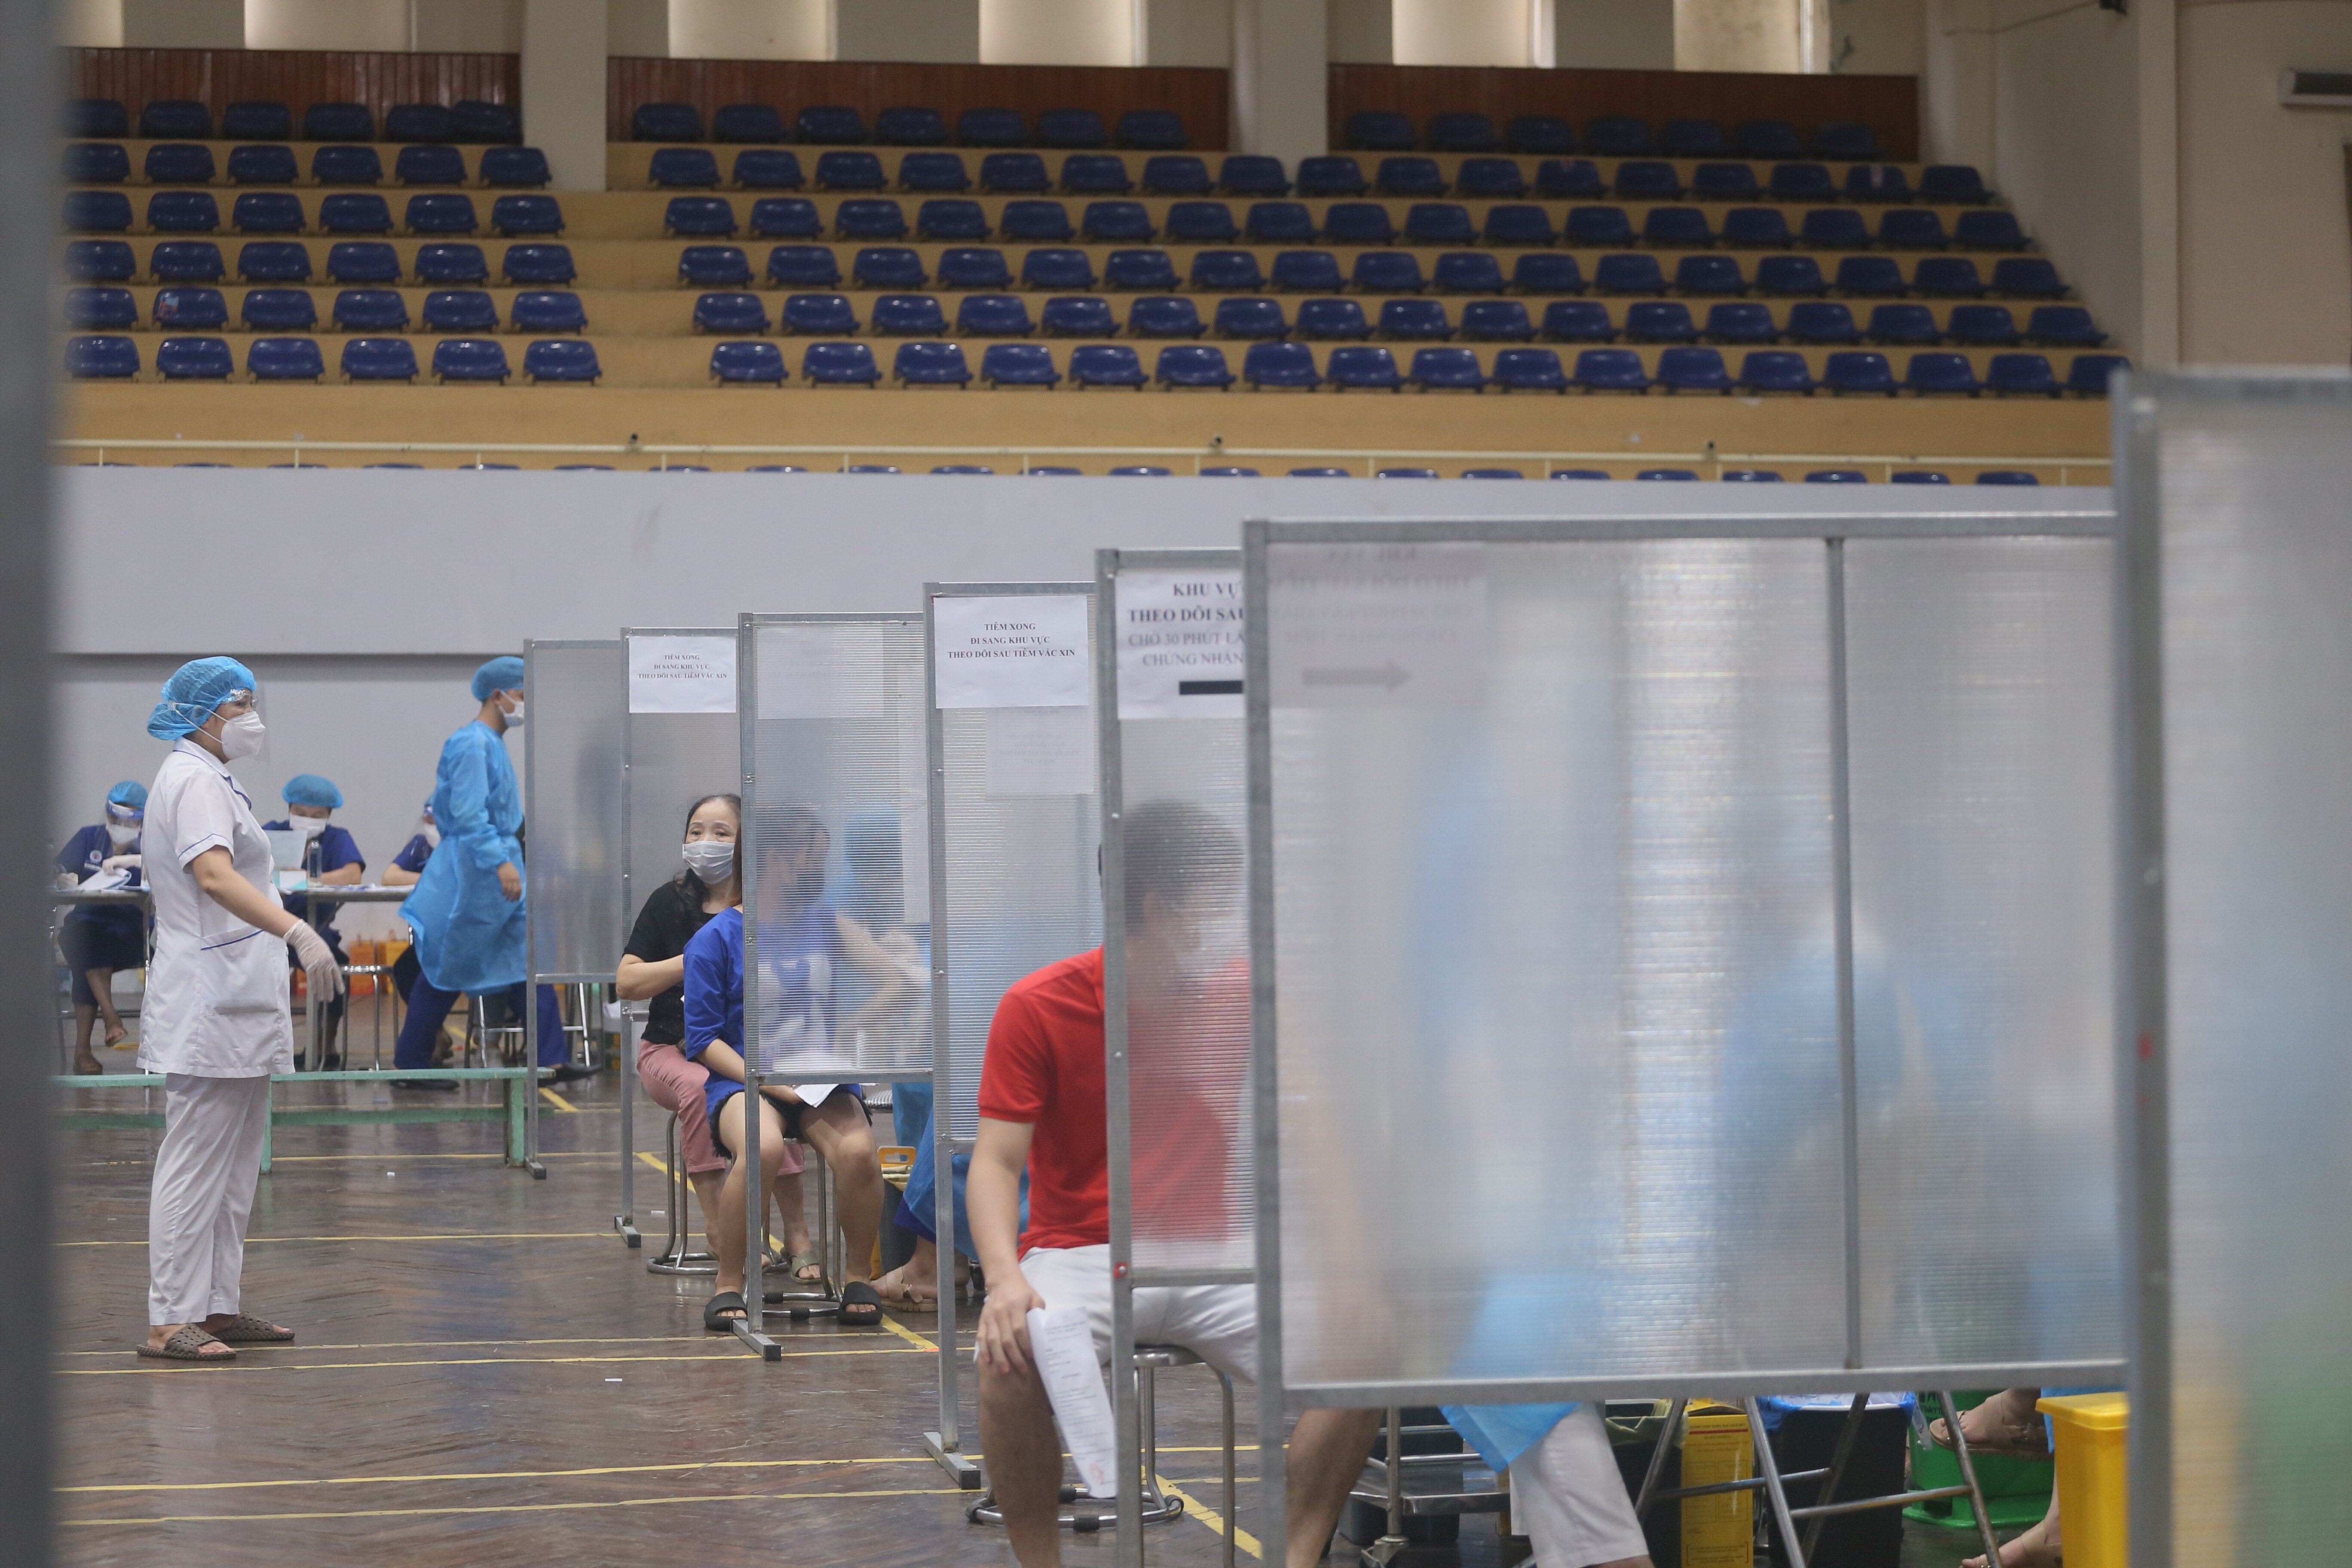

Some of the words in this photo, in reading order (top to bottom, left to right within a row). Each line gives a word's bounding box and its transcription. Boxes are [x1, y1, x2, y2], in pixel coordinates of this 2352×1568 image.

[1173, 583, 1210, 597] KHU
[1127, 608, 1176, 622] THEO
[984, 622, 1007, 630] TIÊM
[1030, 635, 1050, 645] VỰC
[1165, 633, 1179, 645] 30
[1183, 629, 1220, 645] PHÚT
[975, 649, 991, 658] DÕI
[1013, 649, 1036, 657] TIÊM
